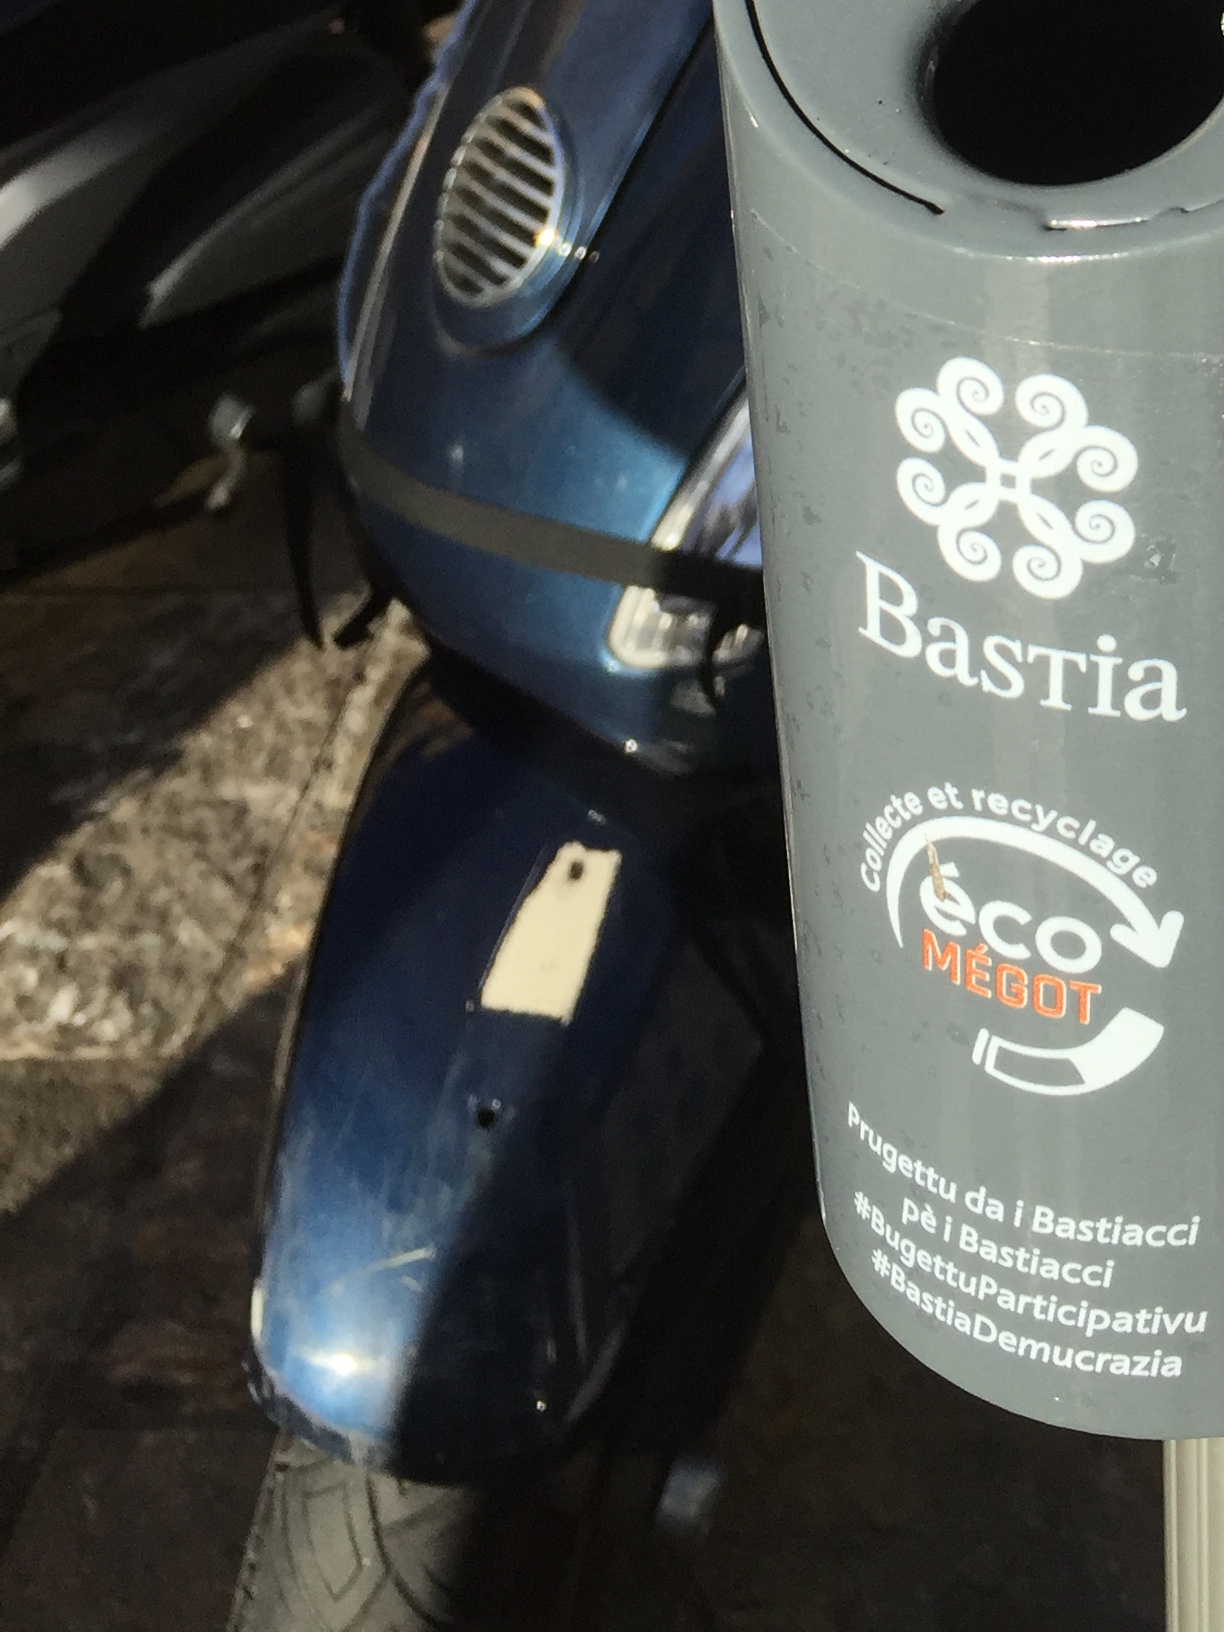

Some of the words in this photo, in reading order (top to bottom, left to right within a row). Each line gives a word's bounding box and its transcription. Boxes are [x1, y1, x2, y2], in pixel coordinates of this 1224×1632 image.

[926, 781, 965, 811] et
[970, 785, 1159, 890] recyclage
[920, 927, 1102, 1026] MÉGOT
[847, 1100, 958, 1204] Prugettu
[963, 1185, 1005, 1223] da
[1012, 1199, 1025, 1229] i
[1030, 1204, 1201, 1248] Bastiacci
[853, 1190, 1209, 1338] #BugettuParticipativu
[942, 1214, 954, 1243] i
[957, 1222, 1116, 1289] Bastiacci
[870, 1248, 1184, 1378] #BastiaDemucrazia
